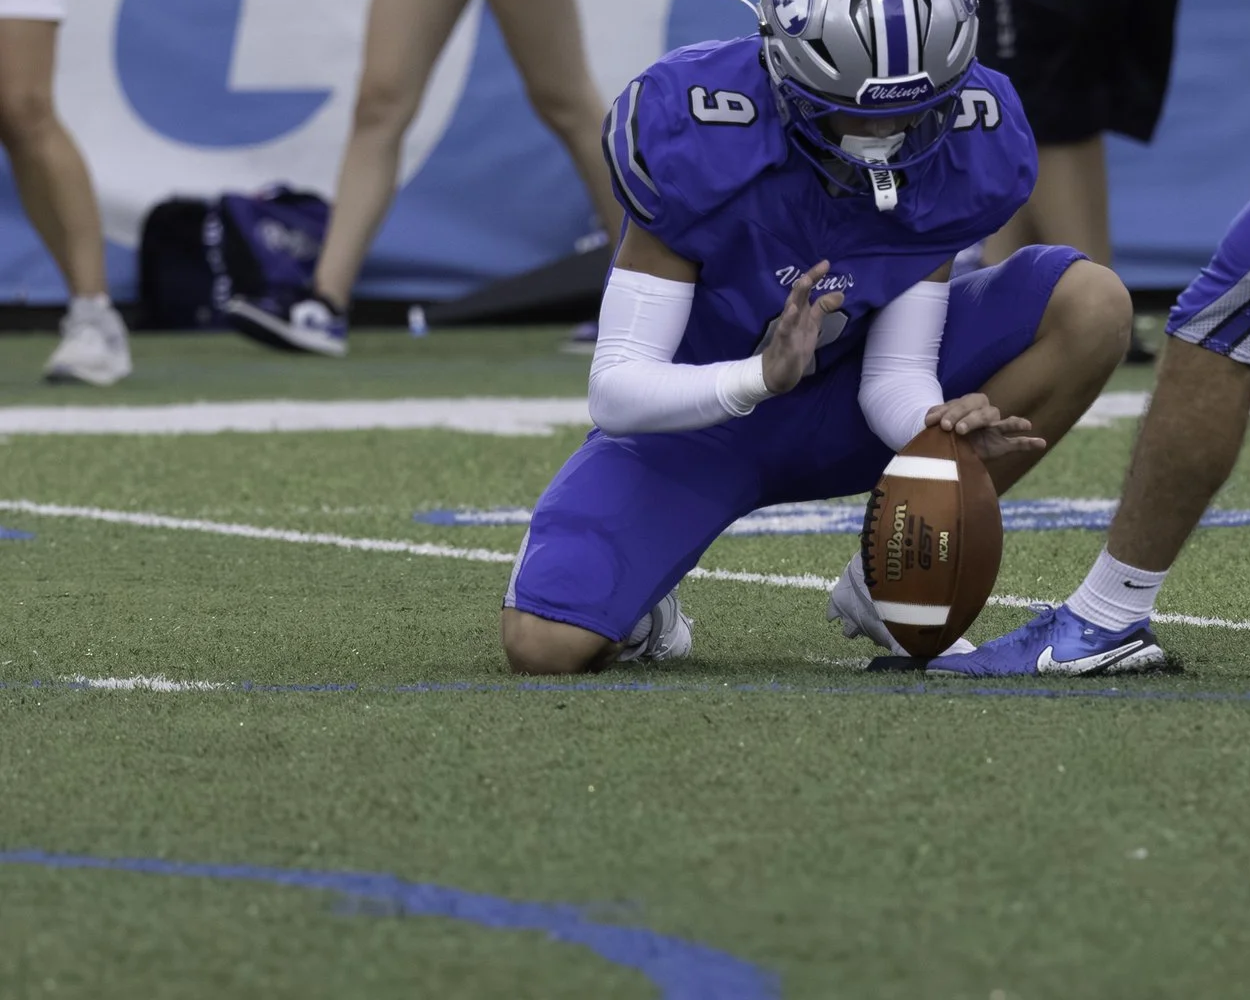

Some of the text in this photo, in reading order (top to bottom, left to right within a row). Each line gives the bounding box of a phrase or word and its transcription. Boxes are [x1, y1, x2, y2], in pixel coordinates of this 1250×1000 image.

[690, 86, 757, 125] 9
[867, 84, 929, 99] Vikings
[887, 504, 907, 581] Wilson
[939, 531, 950, 562] NCAA
